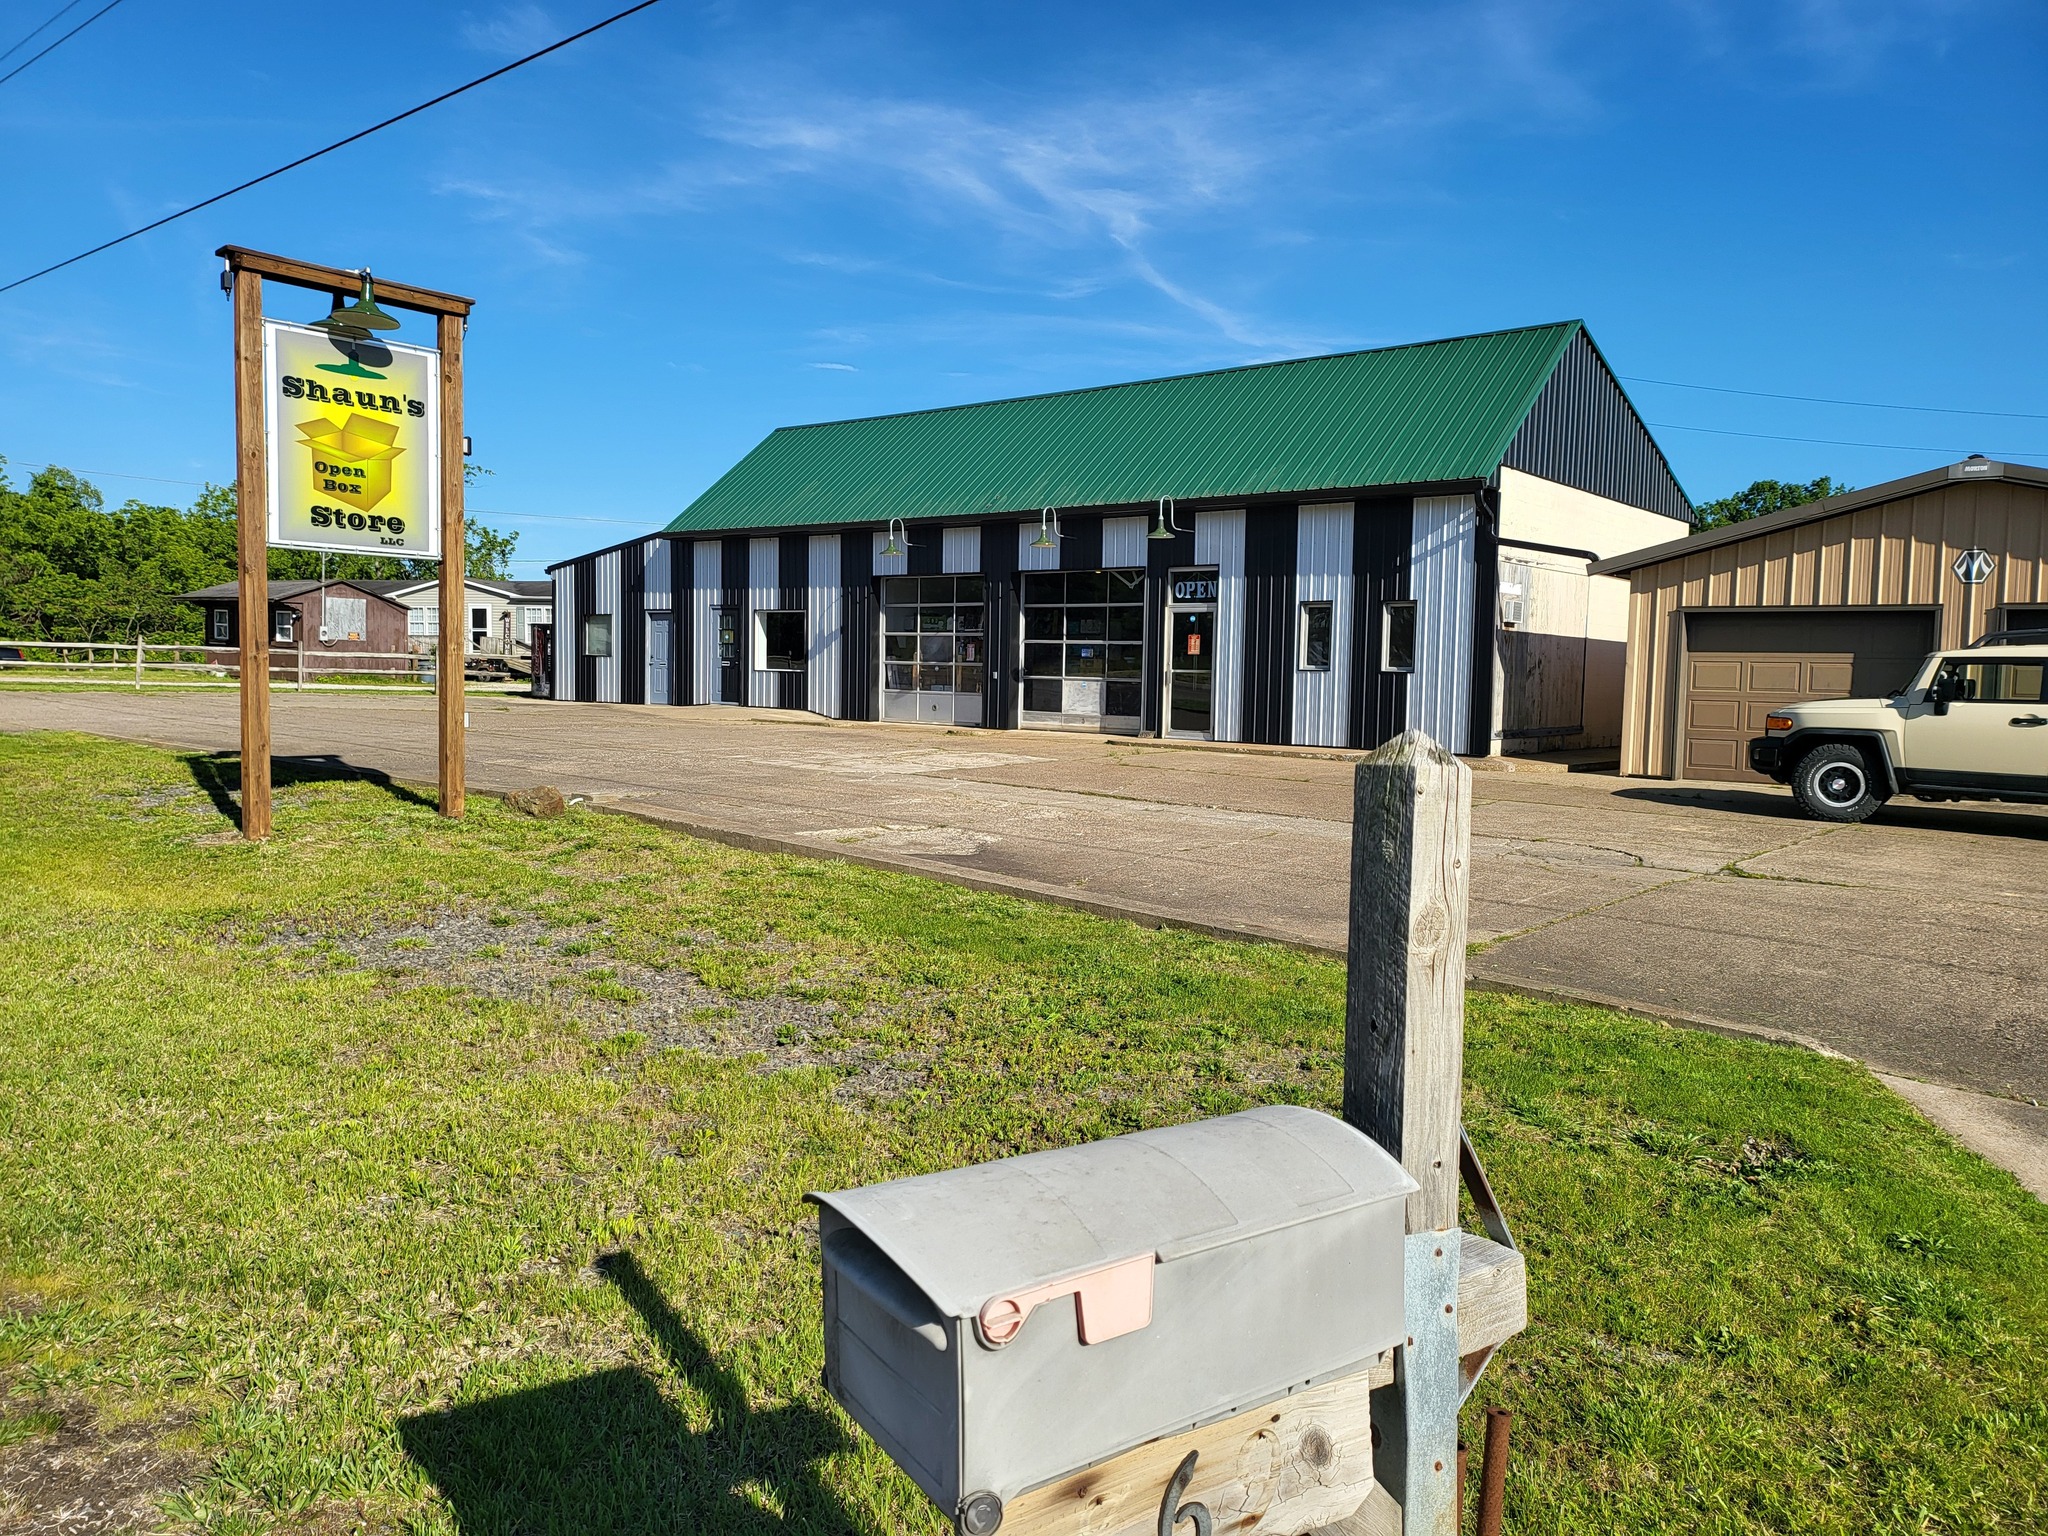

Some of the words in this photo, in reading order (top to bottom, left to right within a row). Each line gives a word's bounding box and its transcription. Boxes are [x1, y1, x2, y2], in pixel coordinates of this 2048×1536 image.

[281, 375, 425, 417] Shaun's
[314, 461, 366, 479] Open
[322, 479, 362, 494] Box
[310, 505, 405, 534] Store
[380, 536, 404, 546] LLC
[1175, 581, 1217, 599] OPEN
